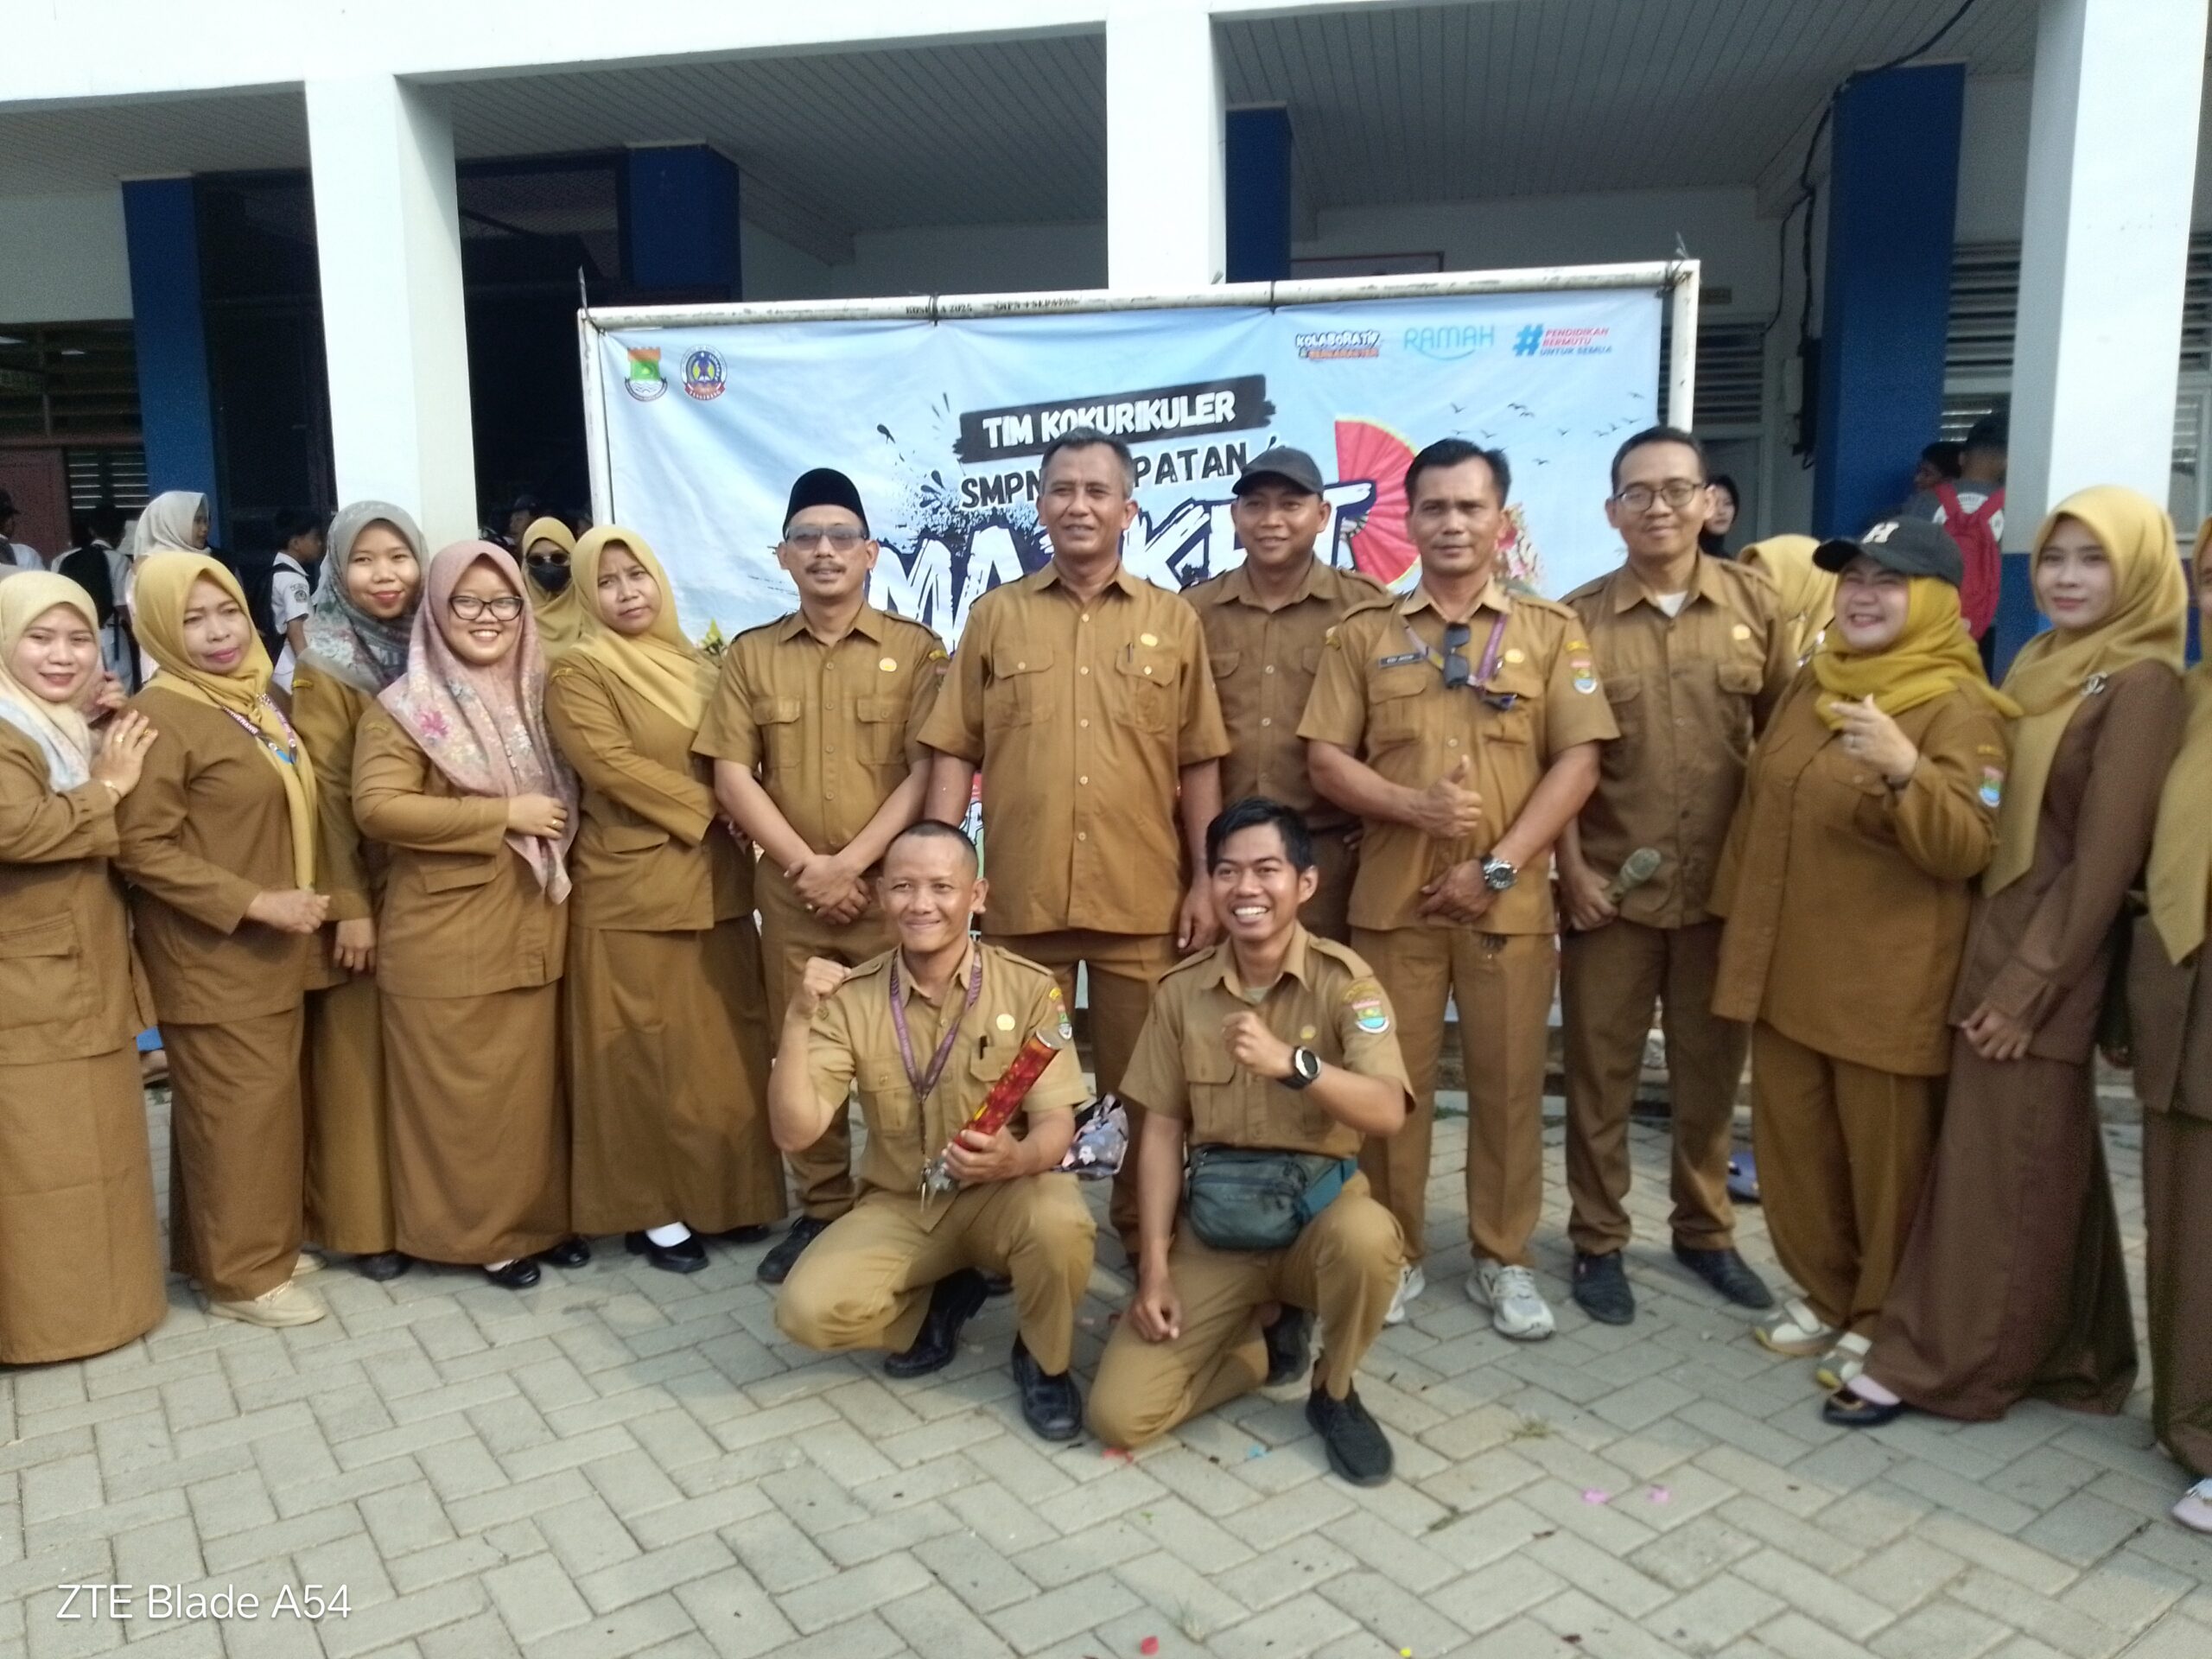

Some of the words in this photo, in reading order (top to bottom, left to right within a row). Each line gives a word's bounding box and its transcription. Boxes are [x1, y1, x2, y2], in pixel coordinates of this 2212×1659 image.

[1404, 324, 1496, 351] RAMAH
[1542, 337, 1592, 346] BERMUTU
[1544, 327, 1610, 338] PENDIDIKAN
[1540, 346, 1574, 357] UNTUK
[982, 413, 1033, 448] TIM
[1041, 390, 1236, 443] KOKURIKULER
[1133, 442, 1248, 488] PATAN
[1860, 521, 1899, 543] H
